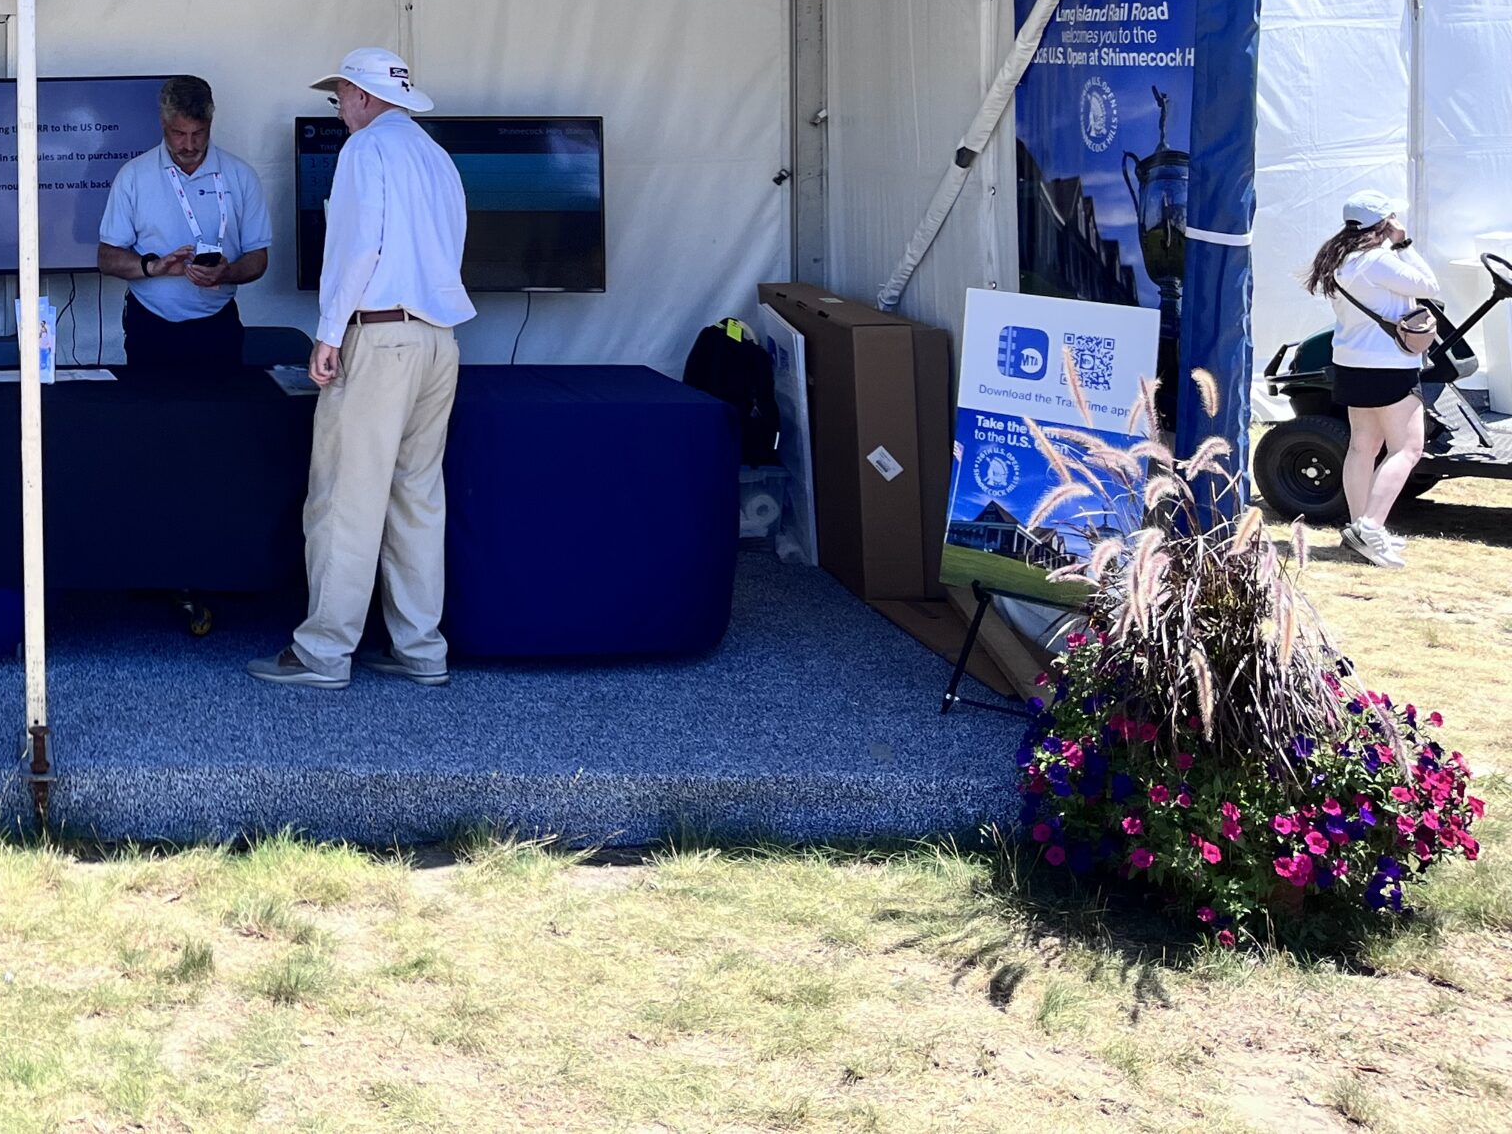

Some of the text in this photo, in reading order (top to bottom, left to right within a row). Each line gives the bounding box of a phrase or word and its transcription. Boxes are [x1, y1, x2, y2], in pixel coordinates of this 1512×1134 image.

[1056, 1, 1169, 25] Long Island Rail Road
[1099, 29, 1118, 47] you
[1118, 28, 1131, 44] to
[1133, 26, 1157, 44] the
[1049, 46, 1066, 65] U.S.
[1066, 47, 1088, 68] Open
[1089, 50, 1099, 66] at
[1100, 47, 1183, 67] Shinnecock
[50, 124, 61, 132] to
[63, 123, 78, 132] the
[80, 123, 93, 131] US
[94, 123, 120, 133] Open
[320, 127, 343, 137] Long
[57, 151, 74, 161] and
[76, 152, 86, 161] to
[88, 150, 129, 162] purchase
[55, 181, 65, 190] to
[66, 180, 89, 189] walk
[90, 180, 111, 189] back
[1021, 353, 1039, 367] MTA
[978, 384, 1032, 401] Download
[1034, 393, 1052, 404] the
[975, 415, 1005, 430] Take
[1007, 421, 1028, 434] the
[974, 429, 986, 441] to
[988, 431, 1006, 444] the
[1008, 434, 1032, 448] U.S.
